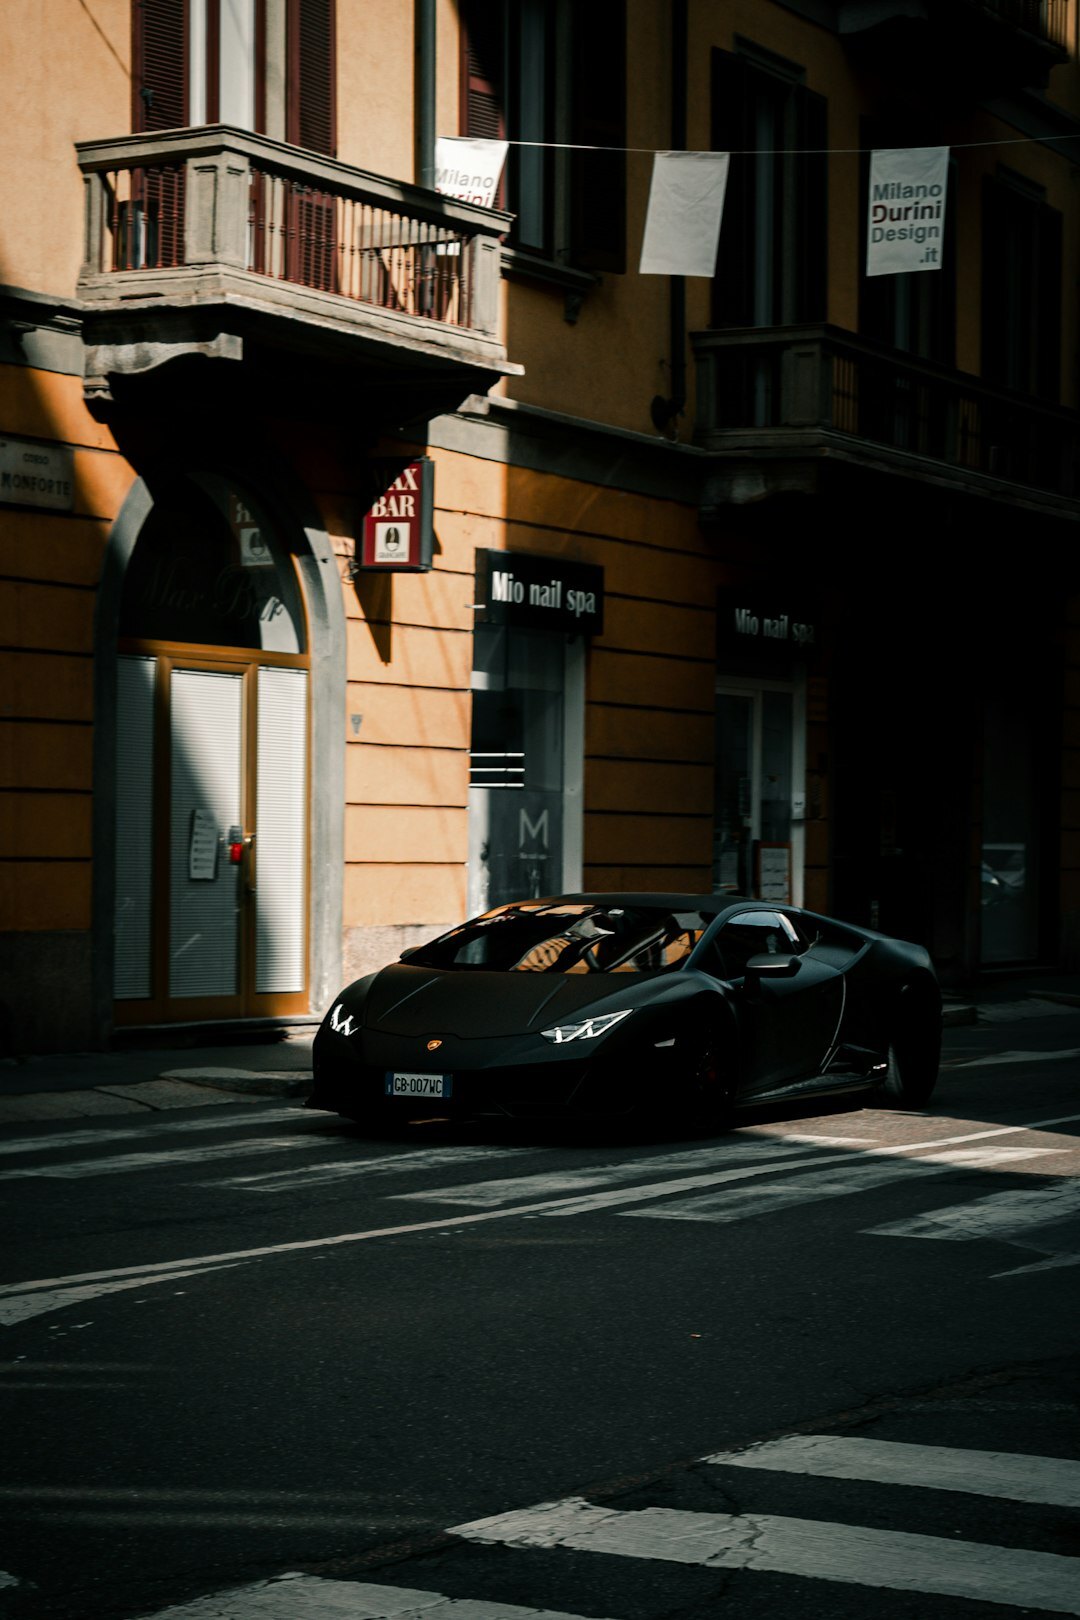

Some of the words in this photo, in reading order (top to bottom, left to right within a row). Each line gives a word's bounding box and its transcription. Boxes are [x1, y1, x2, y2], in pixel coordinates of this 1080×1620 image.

[434, 167, 494, 188] Milano
[873, 182, 942, 201] Milano
[872, 200, 941, 224] Durini
[872, 223, 939, 244] Design
[1, 471, 71, 496] MONFORTE
[370, 495, 416, 518] BAR
[491, 571, 525, 604] Mio
[529, 579, 562, 609] nail
[566, 589, 597, 618] spa
[733, 607, 760, 636] Mio
[762, 613, 789, 640] nail
[791, 622, 815, 648] spa
